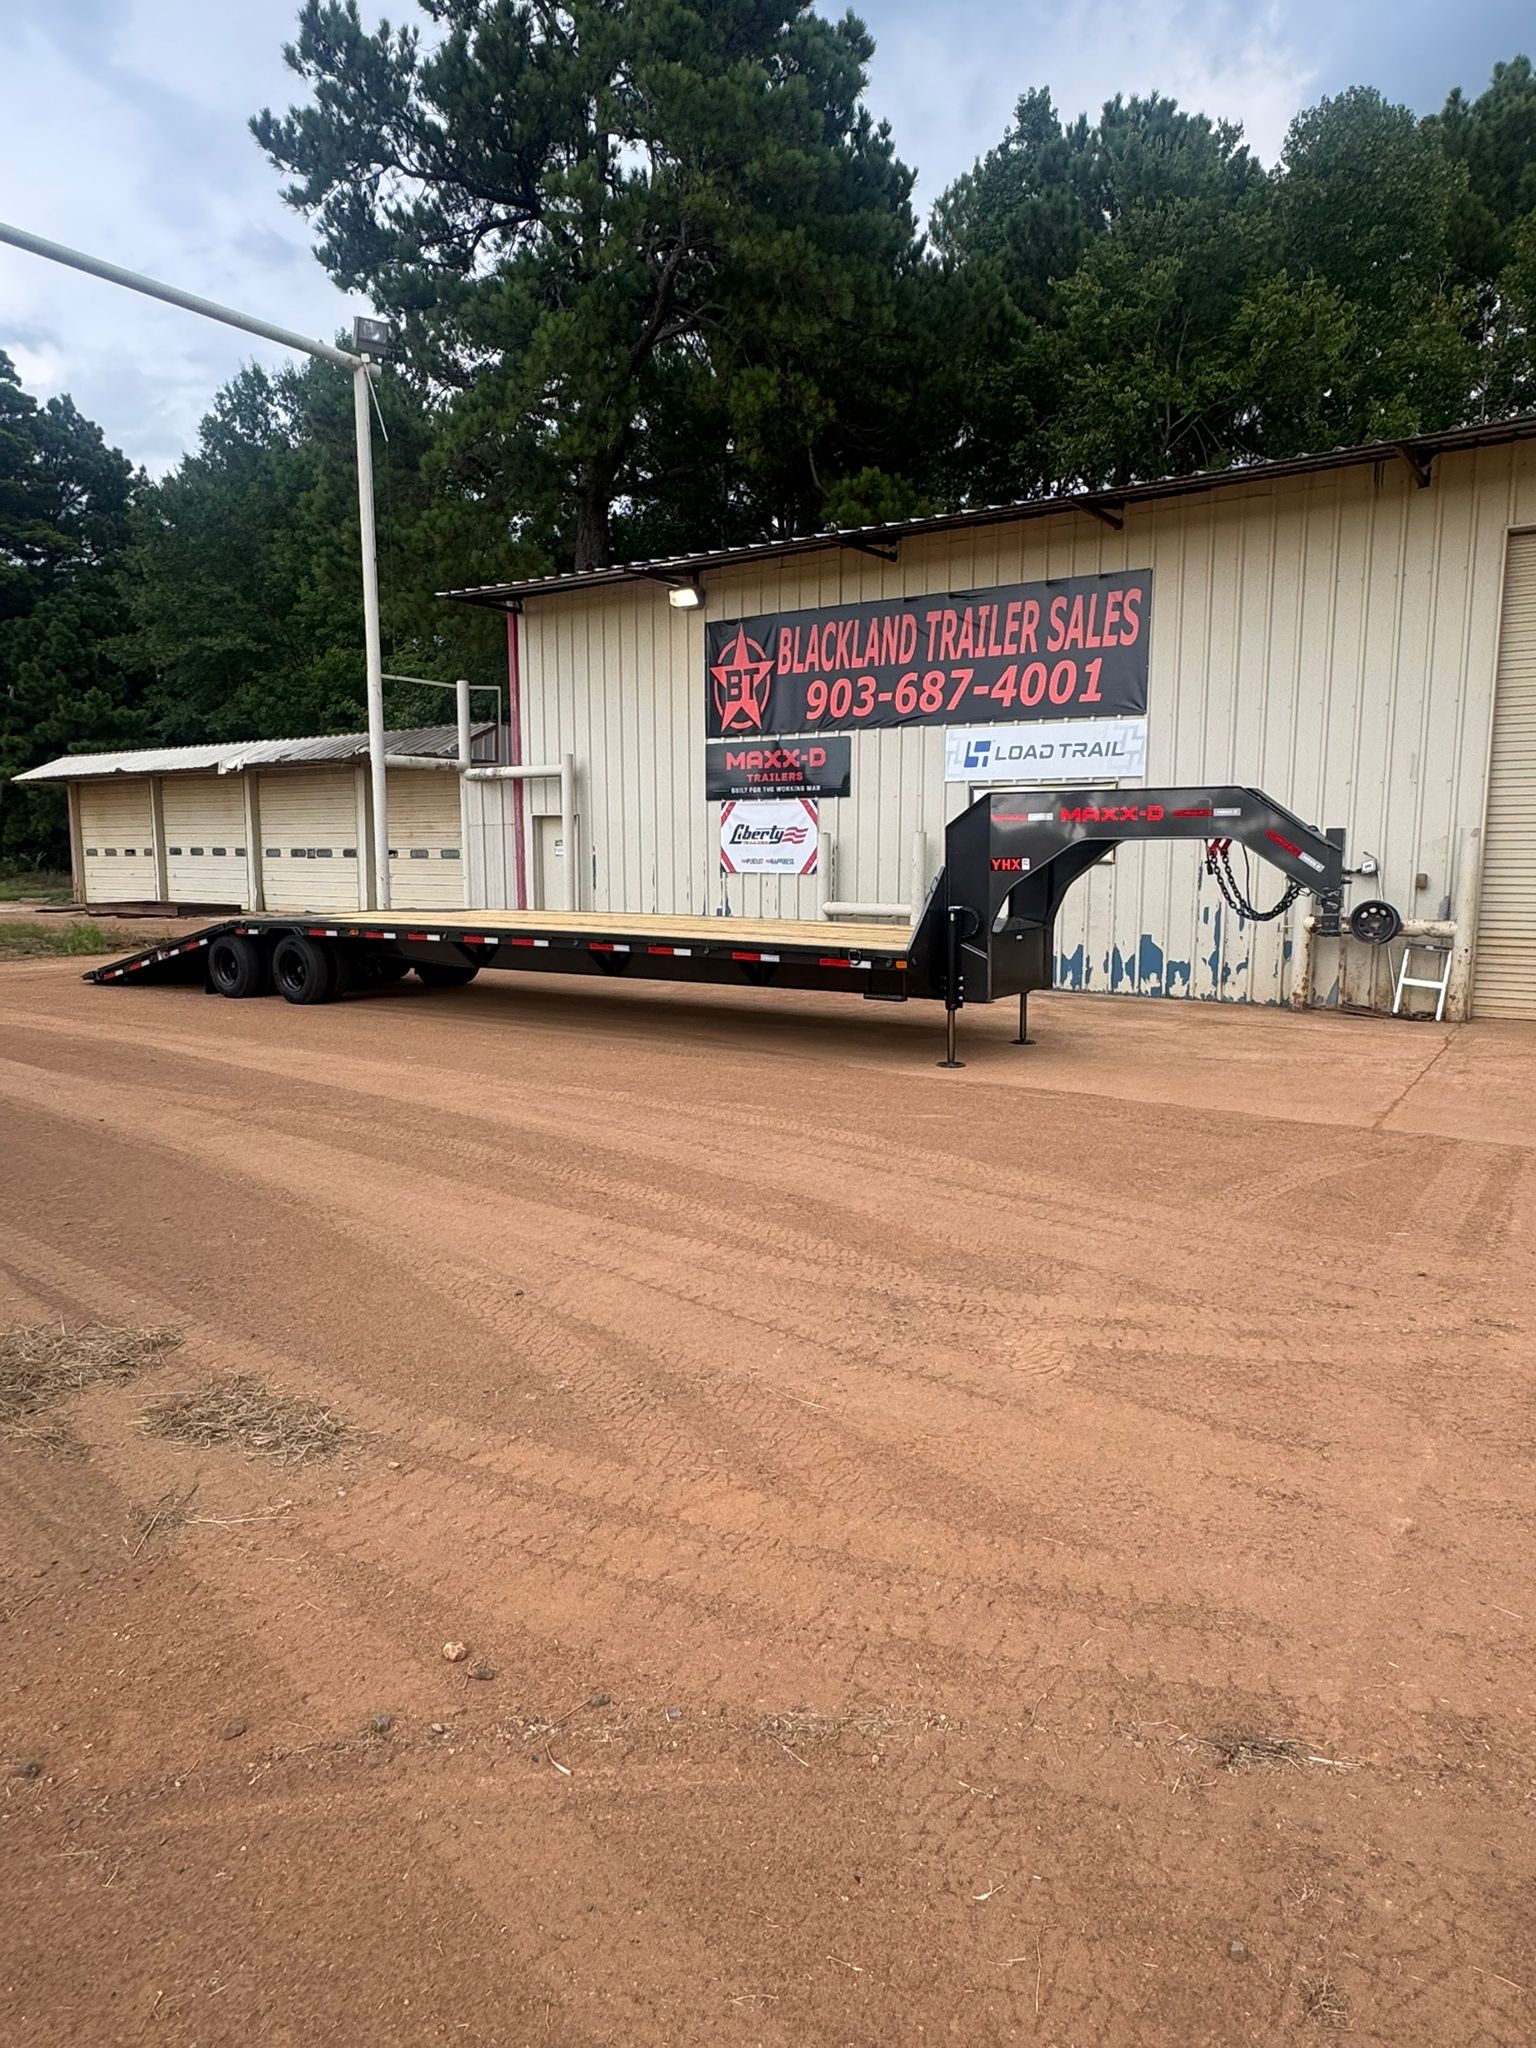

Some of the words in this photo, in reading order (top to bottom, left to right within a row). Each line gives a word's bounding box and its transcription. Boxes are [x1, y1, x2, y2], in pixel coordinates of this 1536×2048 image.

[777, 613, 917, 675] BLACKLAND
[926, 599, 1041, 662] TRAILER
[1046, 587, 1142, 653] SALES
[726, 667, 760, 702] BT
[805, 657, 1103, 720] 903-687-4001
[725, 747, 827, 771] MAXX-D
[994, 744, 1054, 761] LOAD
[1058, 741, 1126, 759] TRAIL
[747, 772, 804, 783] TRAILERS
[749, 786, 761, 794] FOR
[776, 785, 805, 793] WORKING
[1060, 805, 1165, 823] MAXX-D
[729, 823, 785, 845] Liberty
[991, 858, 1021, 871] YHX
